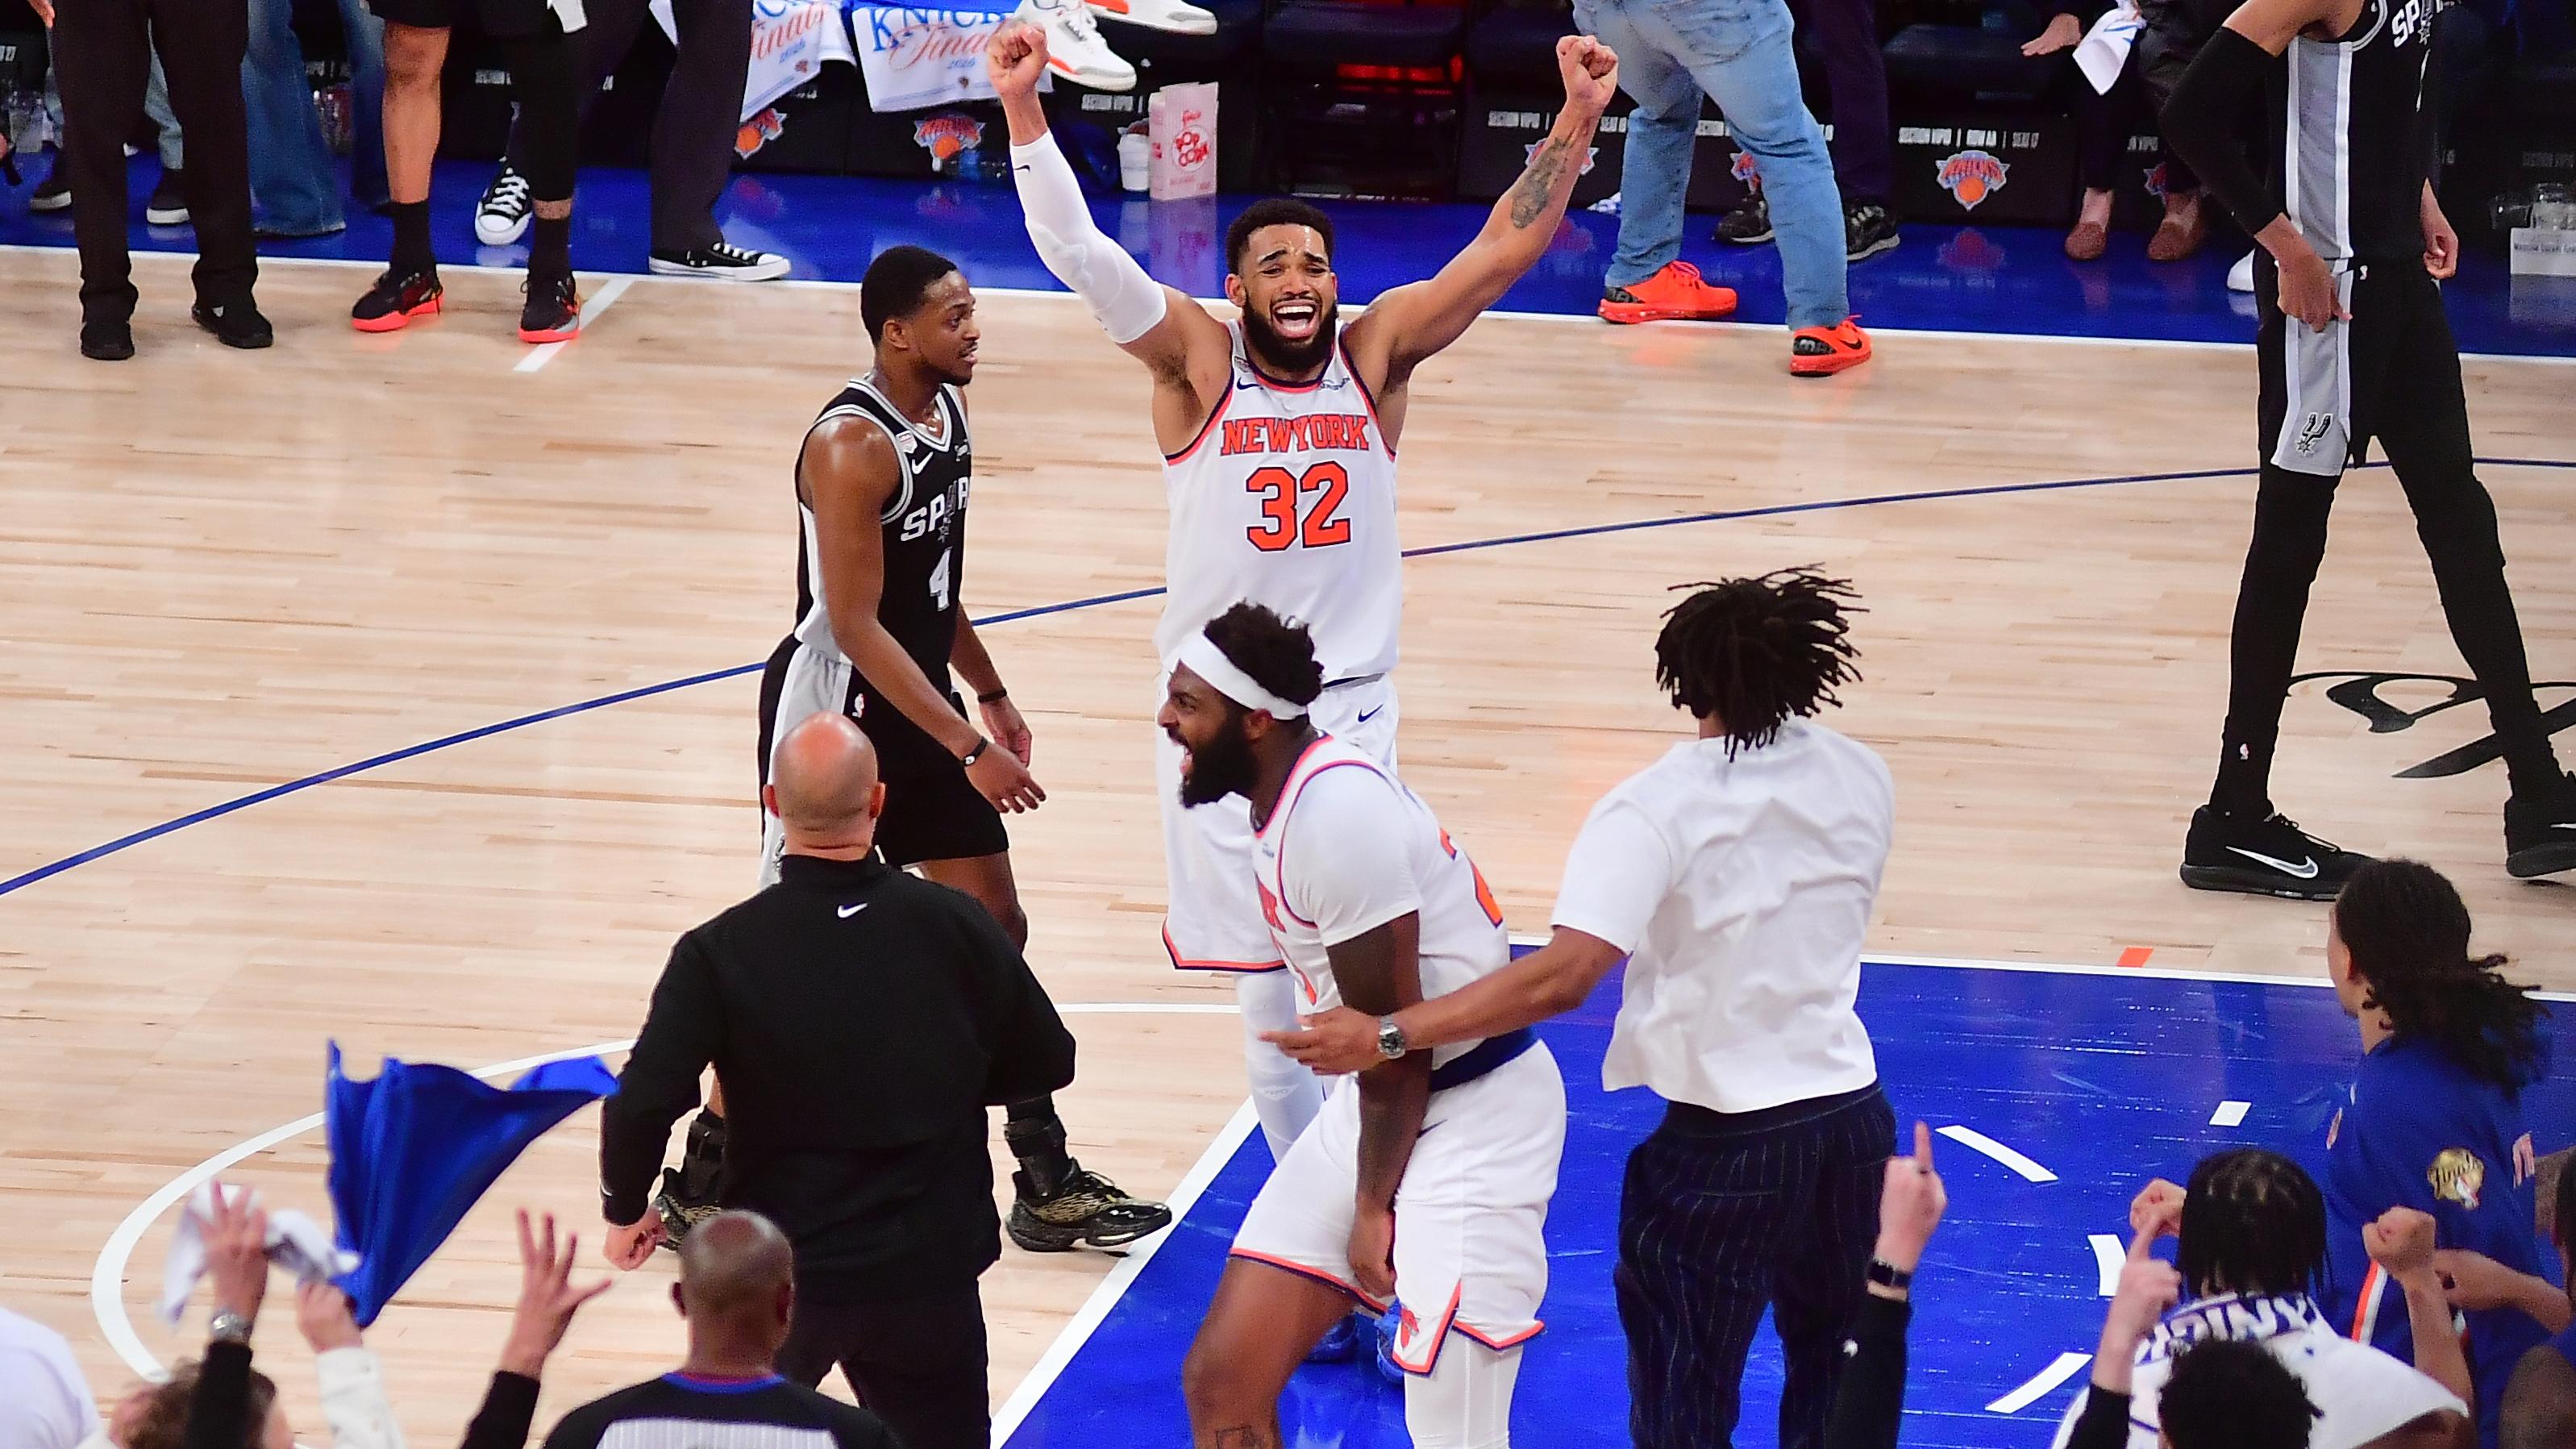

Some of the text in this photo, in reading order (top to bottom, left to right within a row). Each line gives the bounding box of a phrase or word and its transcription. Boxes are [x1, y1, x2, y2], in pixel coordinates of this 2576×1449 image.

[888, 19, 1005, 71] Fina
[1246, 460, 1351, 552] 32
[929, 546, 953, 612] 4
